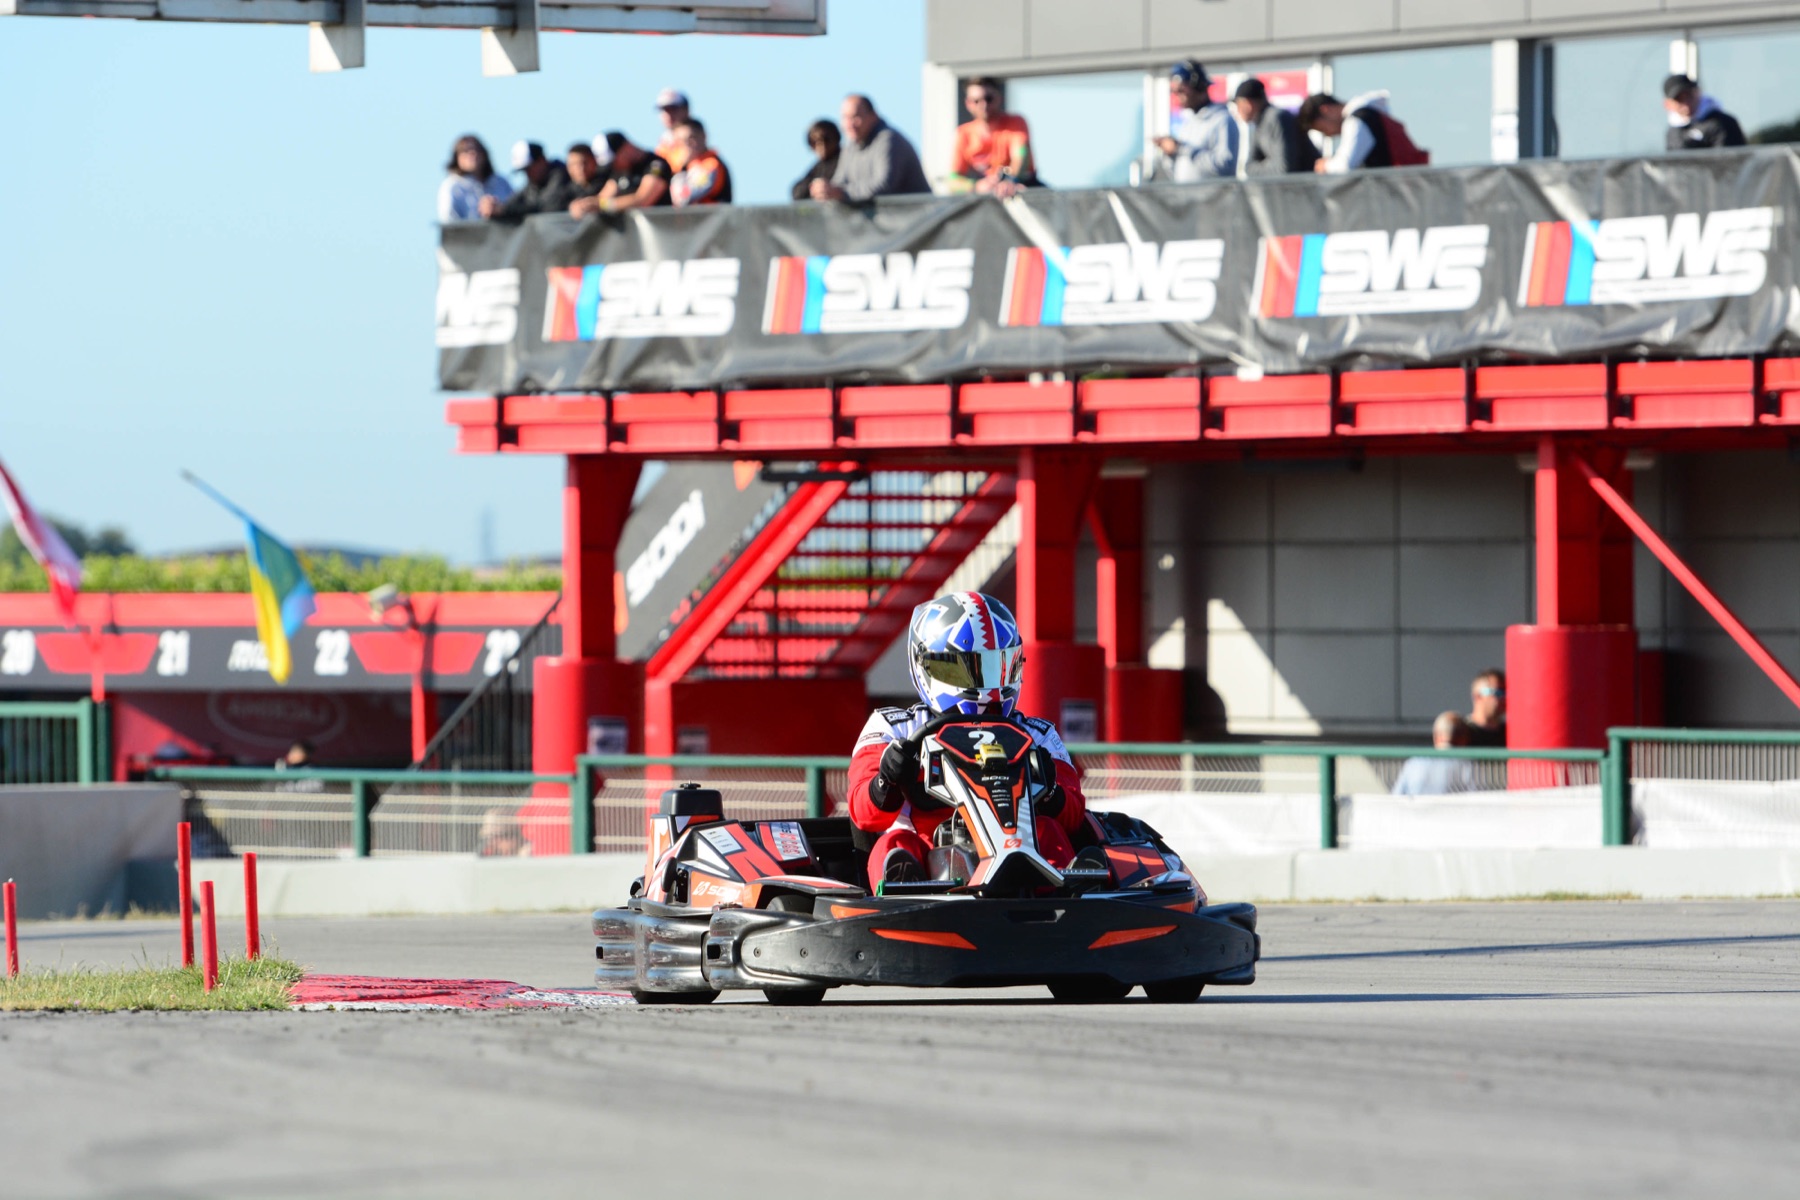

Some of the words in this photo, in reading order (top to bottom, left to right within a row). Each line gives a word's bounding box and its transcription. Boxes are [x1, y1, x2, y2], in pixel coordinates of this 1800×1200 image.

[820, 248, 974, 333] SWS
[1063, 238, 1225, 325] SWS
[1318, 224, 1490, 316] SWS
[1590, 206, 1774, 305] SWS
[595, 257, 740, 340] SWS
[1, 629, 36, 675] 20
[156, 629, 190, 676] 21
[313, 629, 350, 676] 22
